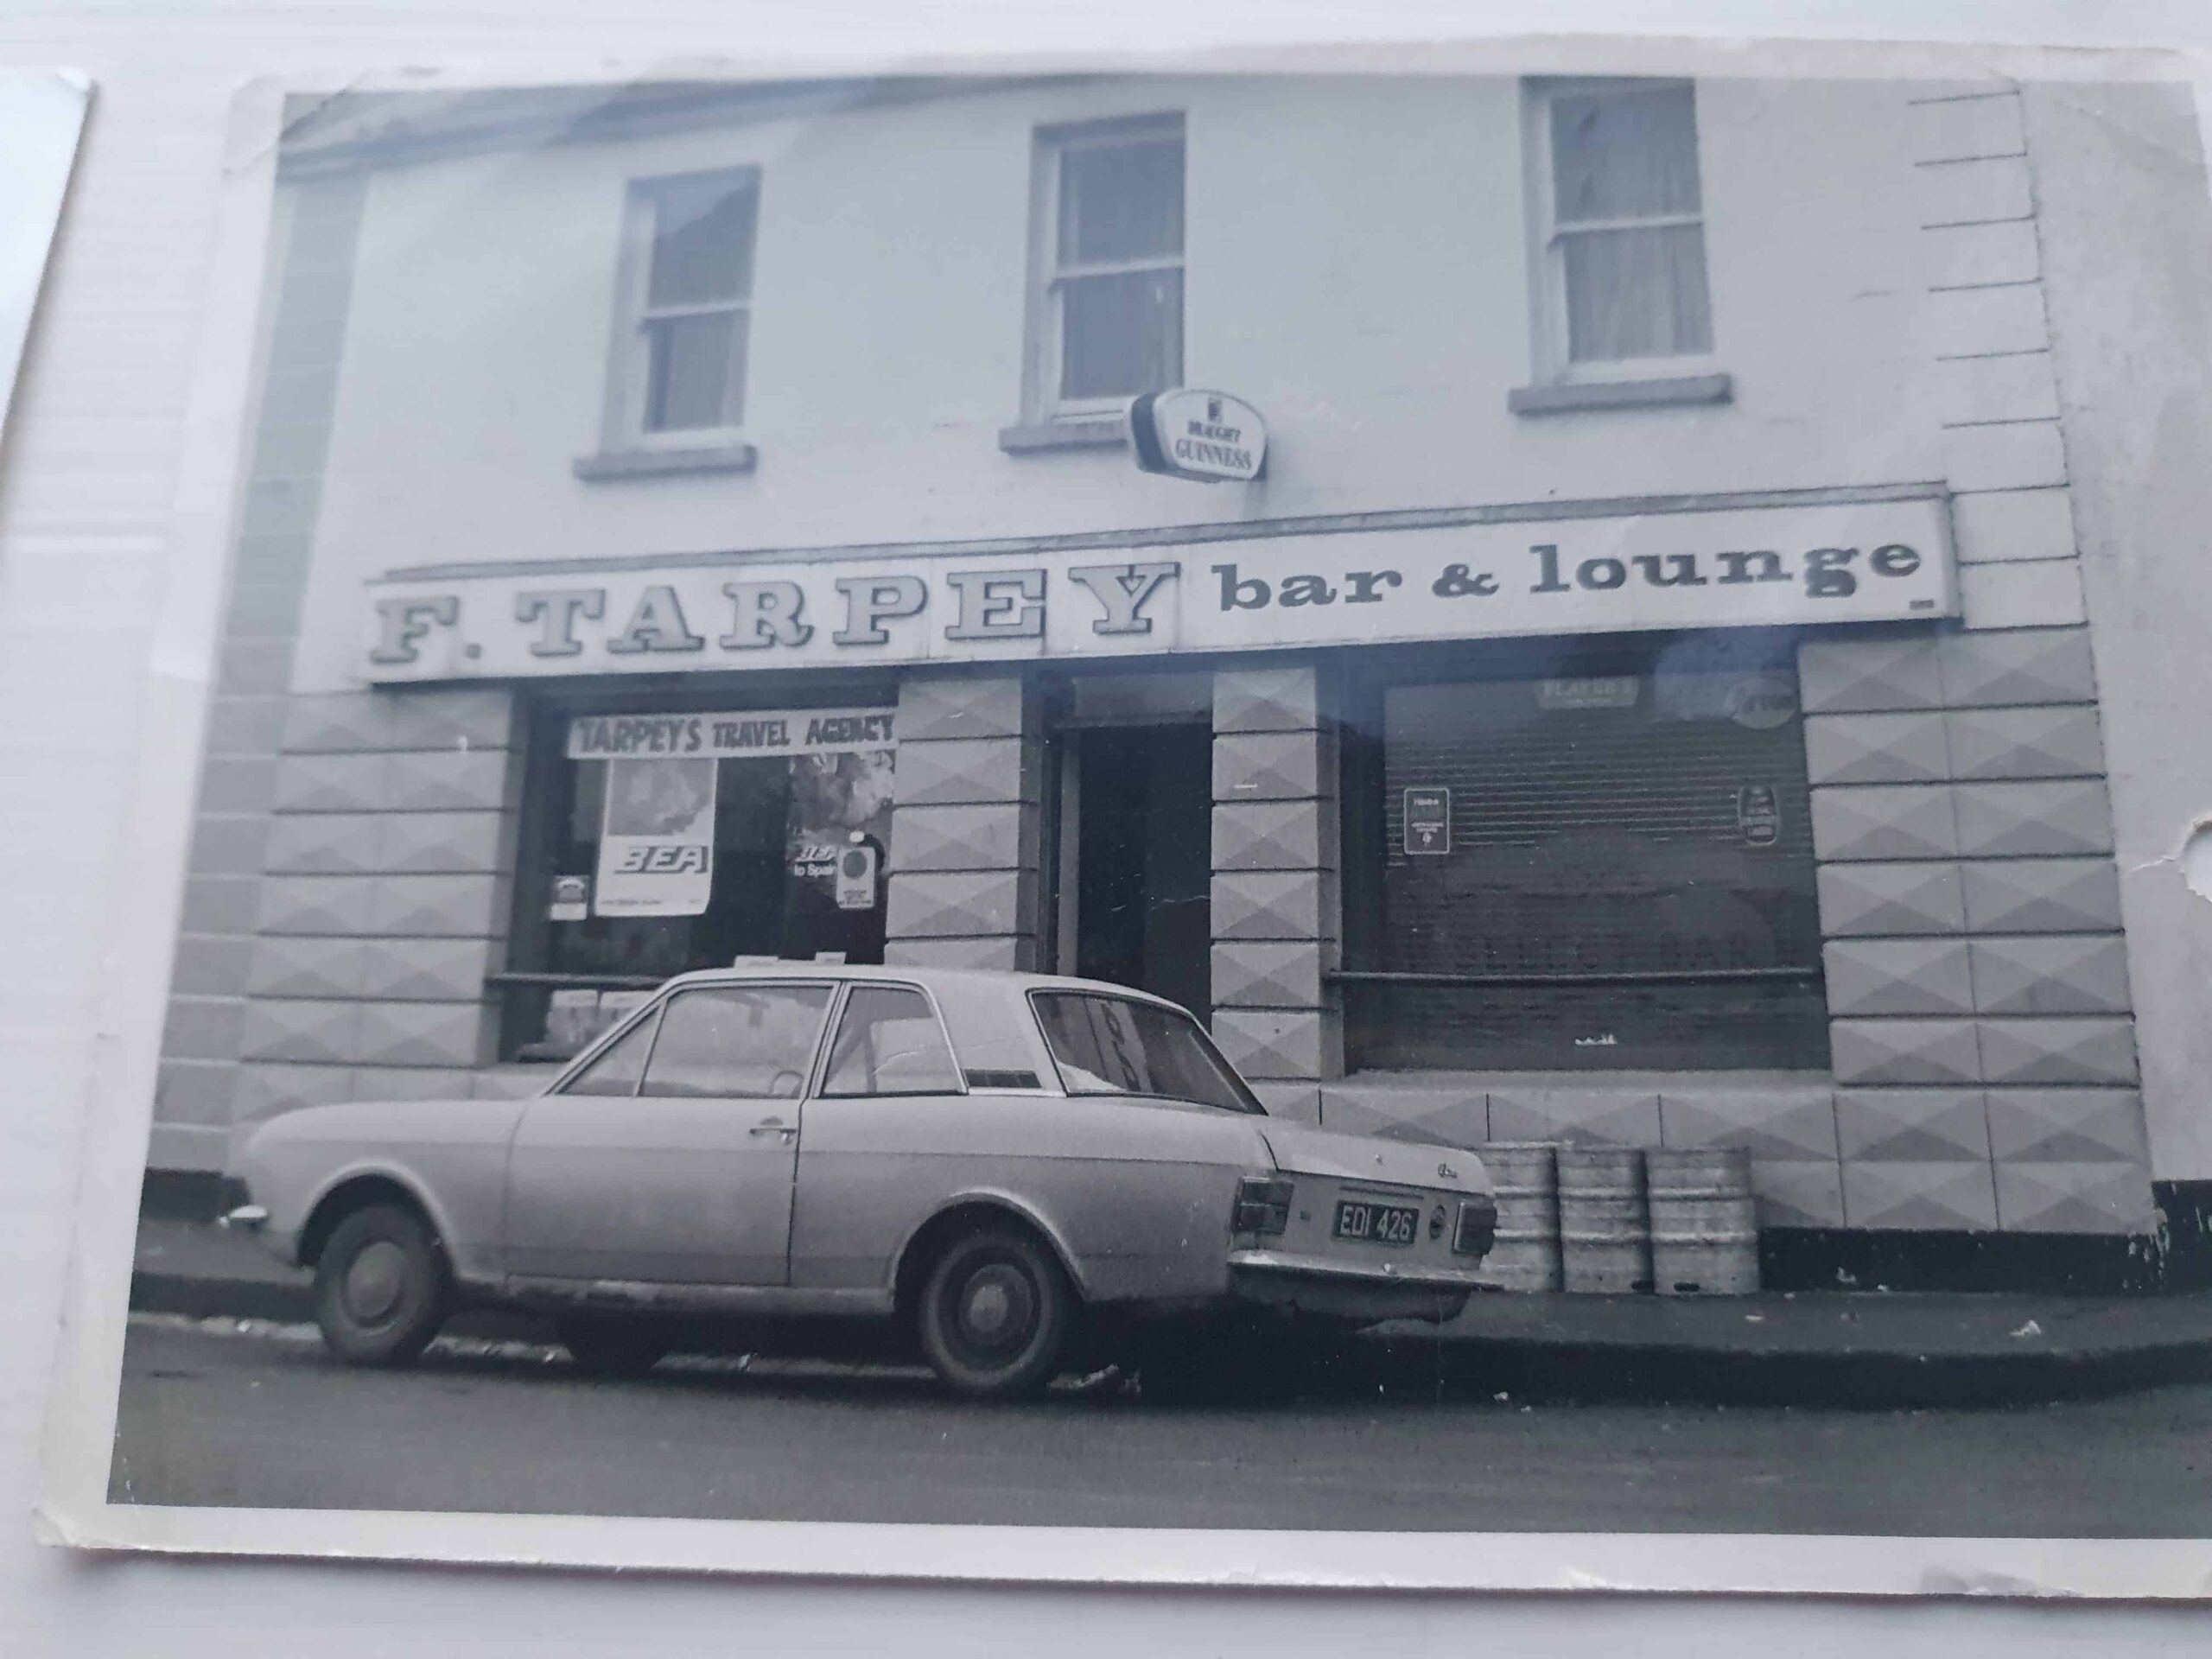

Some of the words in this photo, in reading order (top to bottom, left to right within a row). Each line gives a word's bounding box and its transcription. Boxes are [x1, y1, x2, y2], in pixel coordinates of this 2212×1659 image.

[1176, 439, 1252, 471] GUINNESS
[369, 594, 482, 664] F.
[516, 562, 1180, 658] TARPEY
[1211, 563, 1403, 612] bar
[1432, 563, 1499, 598] &
[1529, 542, 1920, 598] lounge
[713, 720, 791, 747] TRAVEL
[805, 715, 895, 745] AGENCY
[614, 846, 709, 874] BEA
[1340, 1205, 1371, 1236] EDI
[1376, 1209, 1413, 1241] 426
